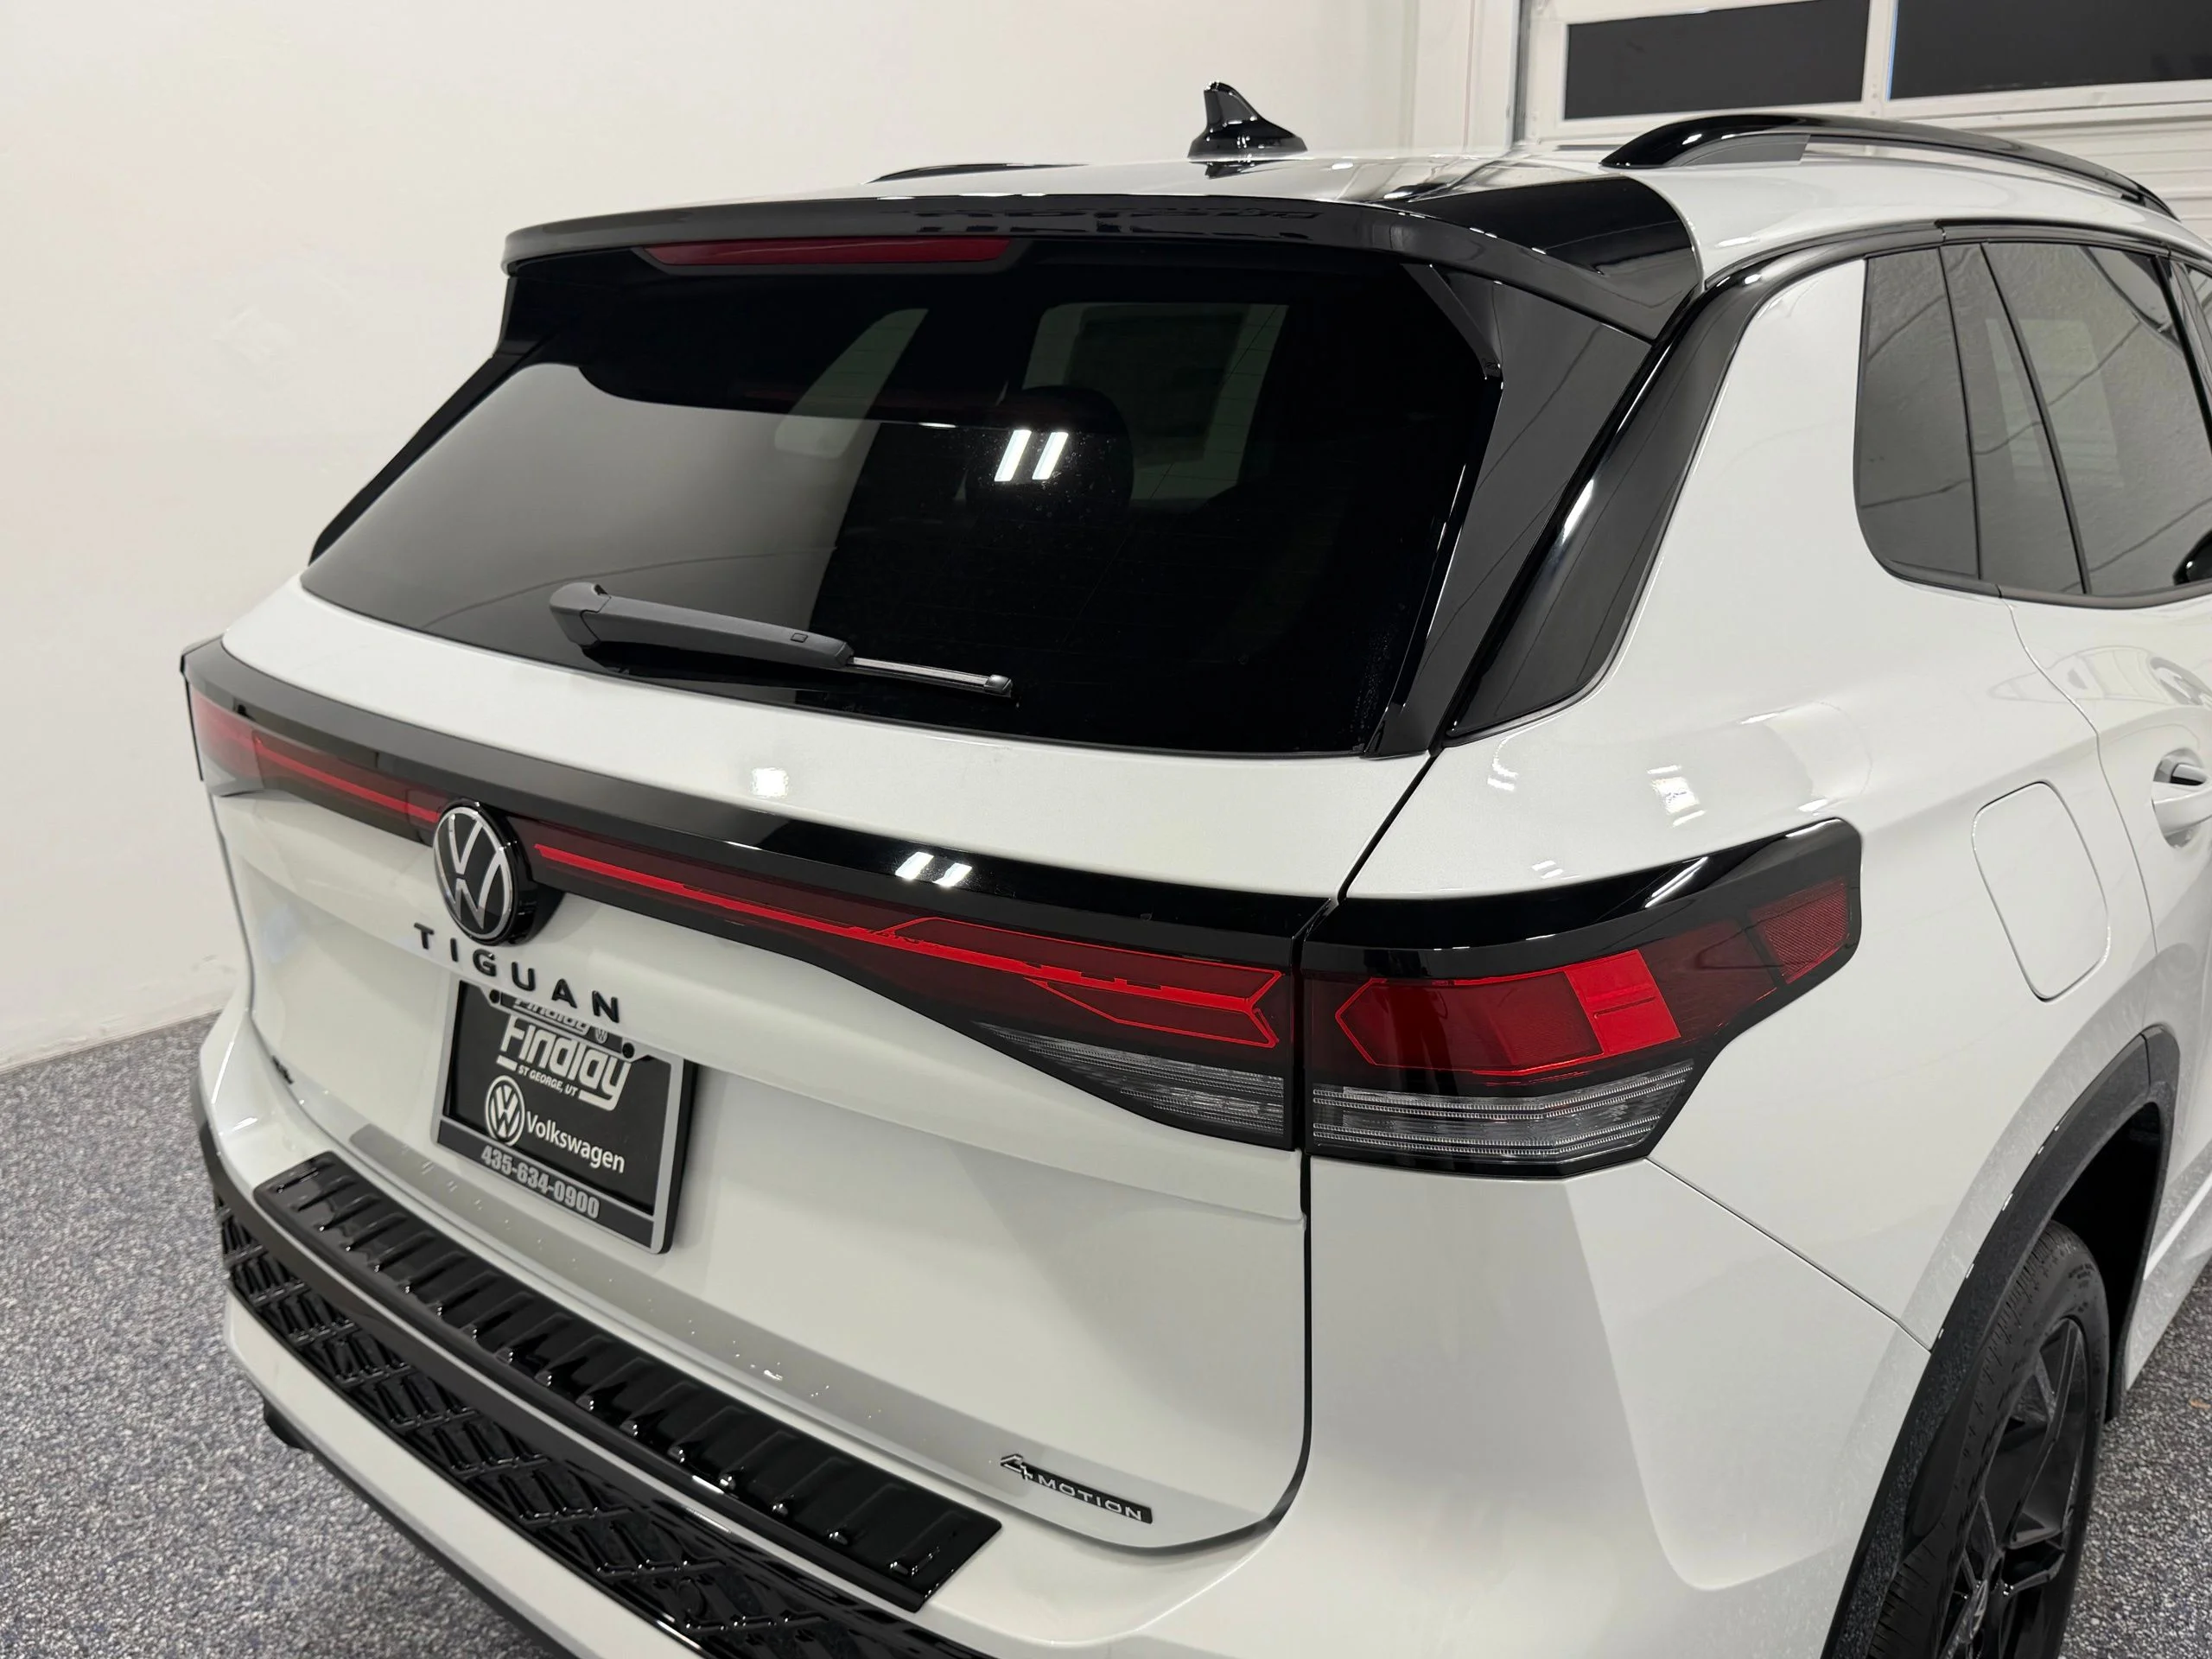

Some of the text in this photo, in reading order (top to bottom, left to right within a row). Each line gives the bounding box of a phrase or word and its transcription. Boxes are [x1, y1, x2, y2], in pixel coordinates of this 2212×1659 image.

[414, 922, 620, 1023] TIGUAN
[497, 1014, 632, 1111] Findlay
[518, 1065, 578, 1096] ST GEORGE, UT
[526, 1110, 625, 1173] Volkswagen
[480, 1145, 600, 1218] 435-634-0900
[1000, 1455, 1142, 1522] 4MOTION
